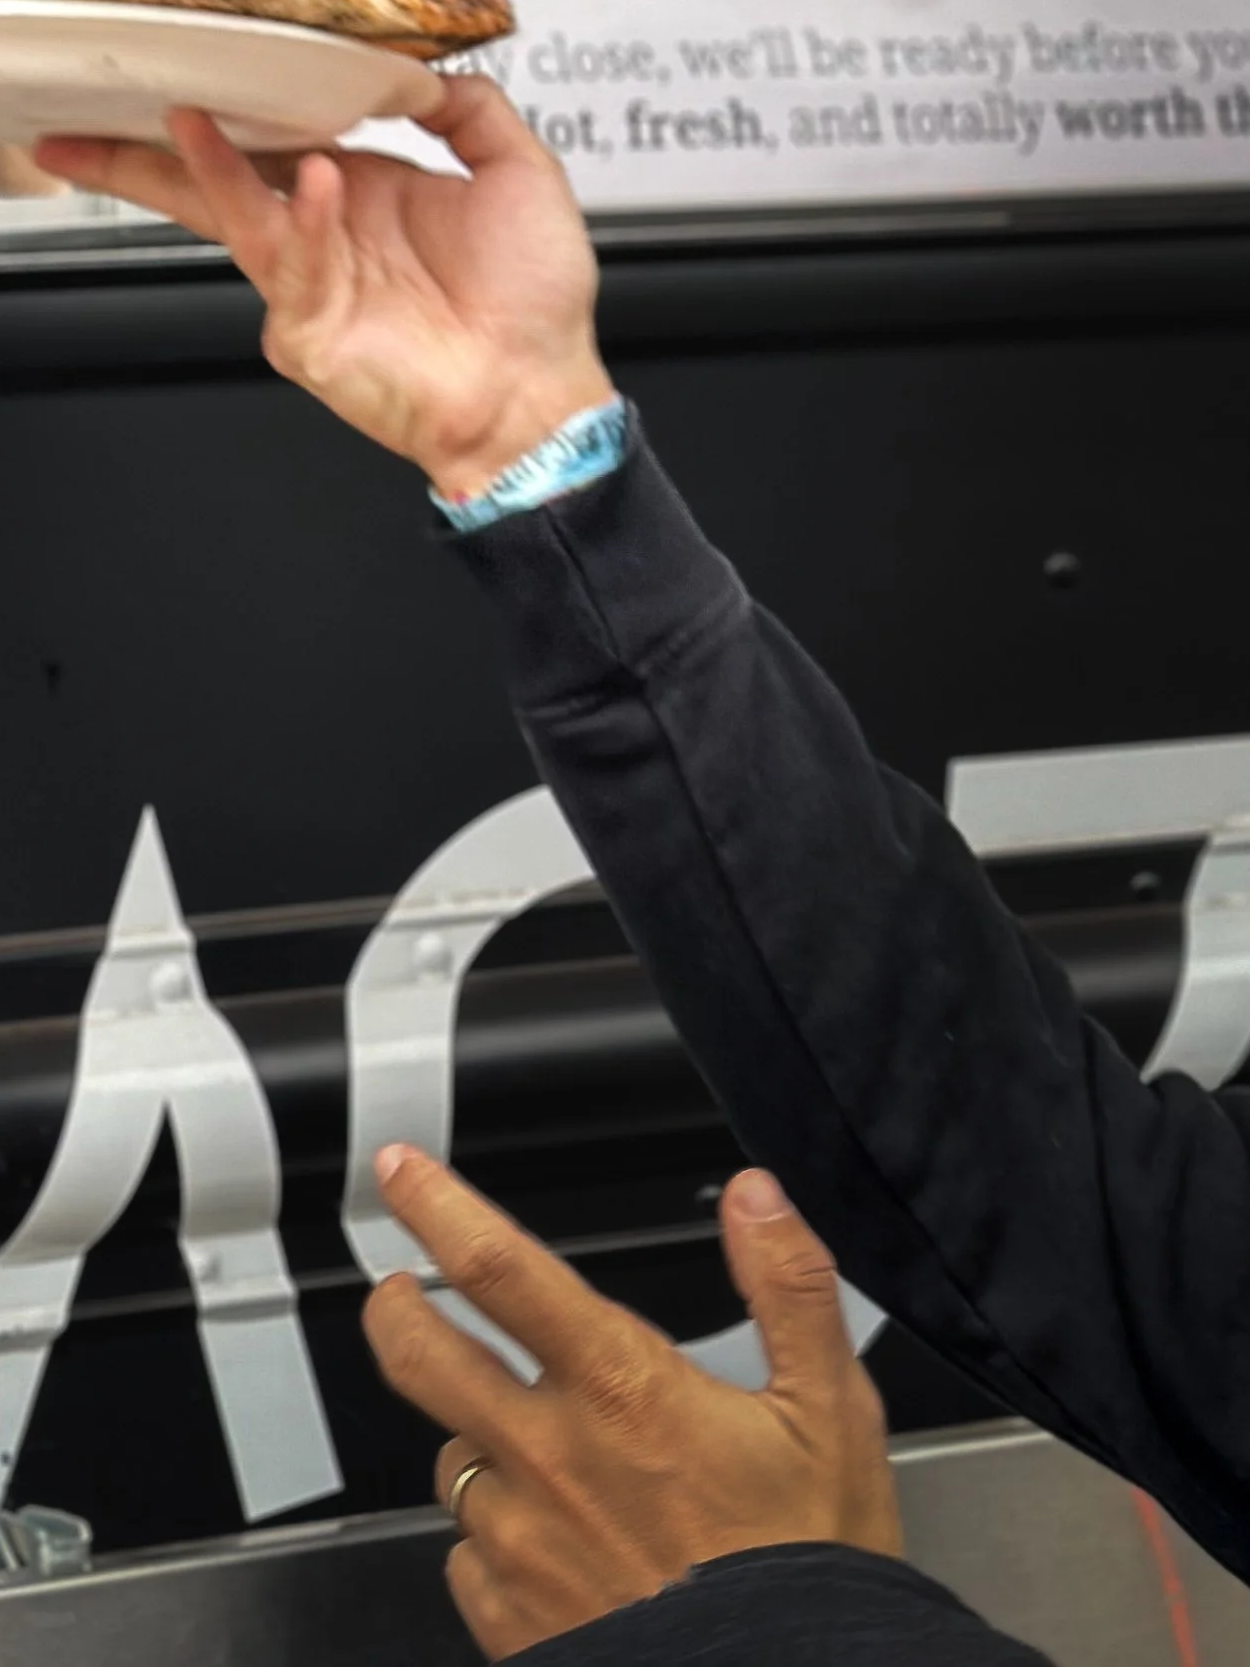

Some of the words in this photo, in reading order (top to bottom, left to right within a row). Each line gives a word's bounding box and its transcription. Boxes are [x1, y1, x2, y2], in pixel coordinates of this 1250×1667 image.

[528, 31, 670, 85] close,
[679, 27, 796, 80] we'll
[806, 27, 868, 77] be
[879, 23, 1016, 85] ready
[1023, 20, 1181, 74] before
[623, 97, 779, 155] fresh,
[789, 91, 882, 146] and
[894, 90, 1044, 156] totally
[1056, 85, 1205, 139] worth
